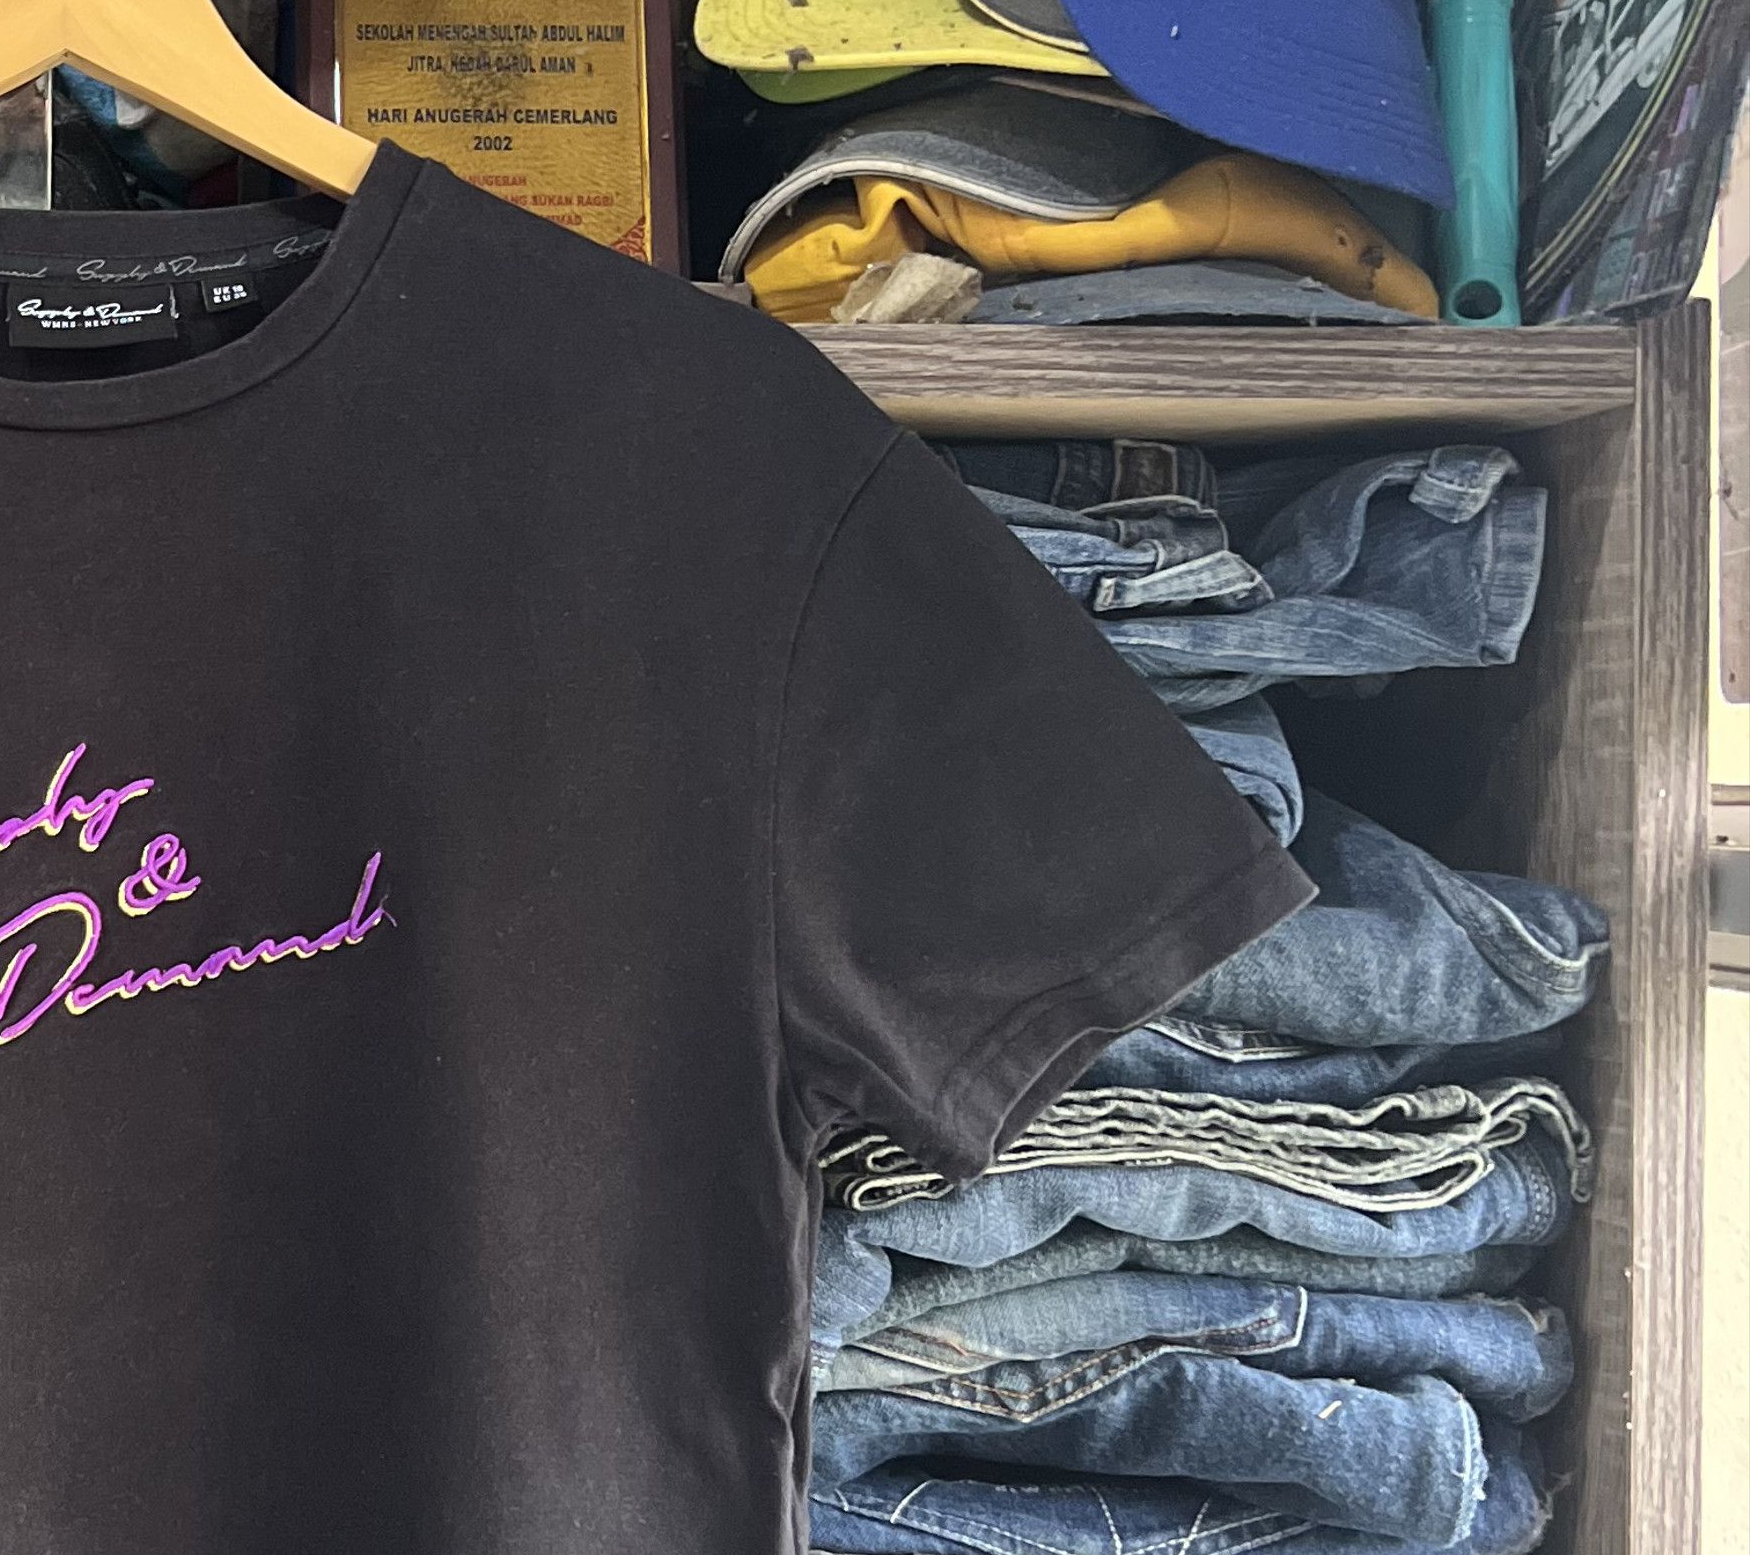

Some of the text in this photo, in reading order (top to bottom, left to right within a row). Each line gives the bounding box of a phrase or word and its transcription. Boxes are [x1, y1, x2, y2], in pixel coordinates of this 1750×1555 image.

[356, 24, 415, 42] SEKOLAH
[541, 25, 584, 42] ABDUL
[586, 25, 626, 42] HALIM
[540, 56, 576, 74] AMAN
[367, 107, 618, 125] HARI ANUGERAH CEMERLANG
[473, 135, 513, 151] 2002
[463, 174, 527, 187] NUGERAH
[153, 261, 168, 275] &
[117, 832, 202, 917] &
